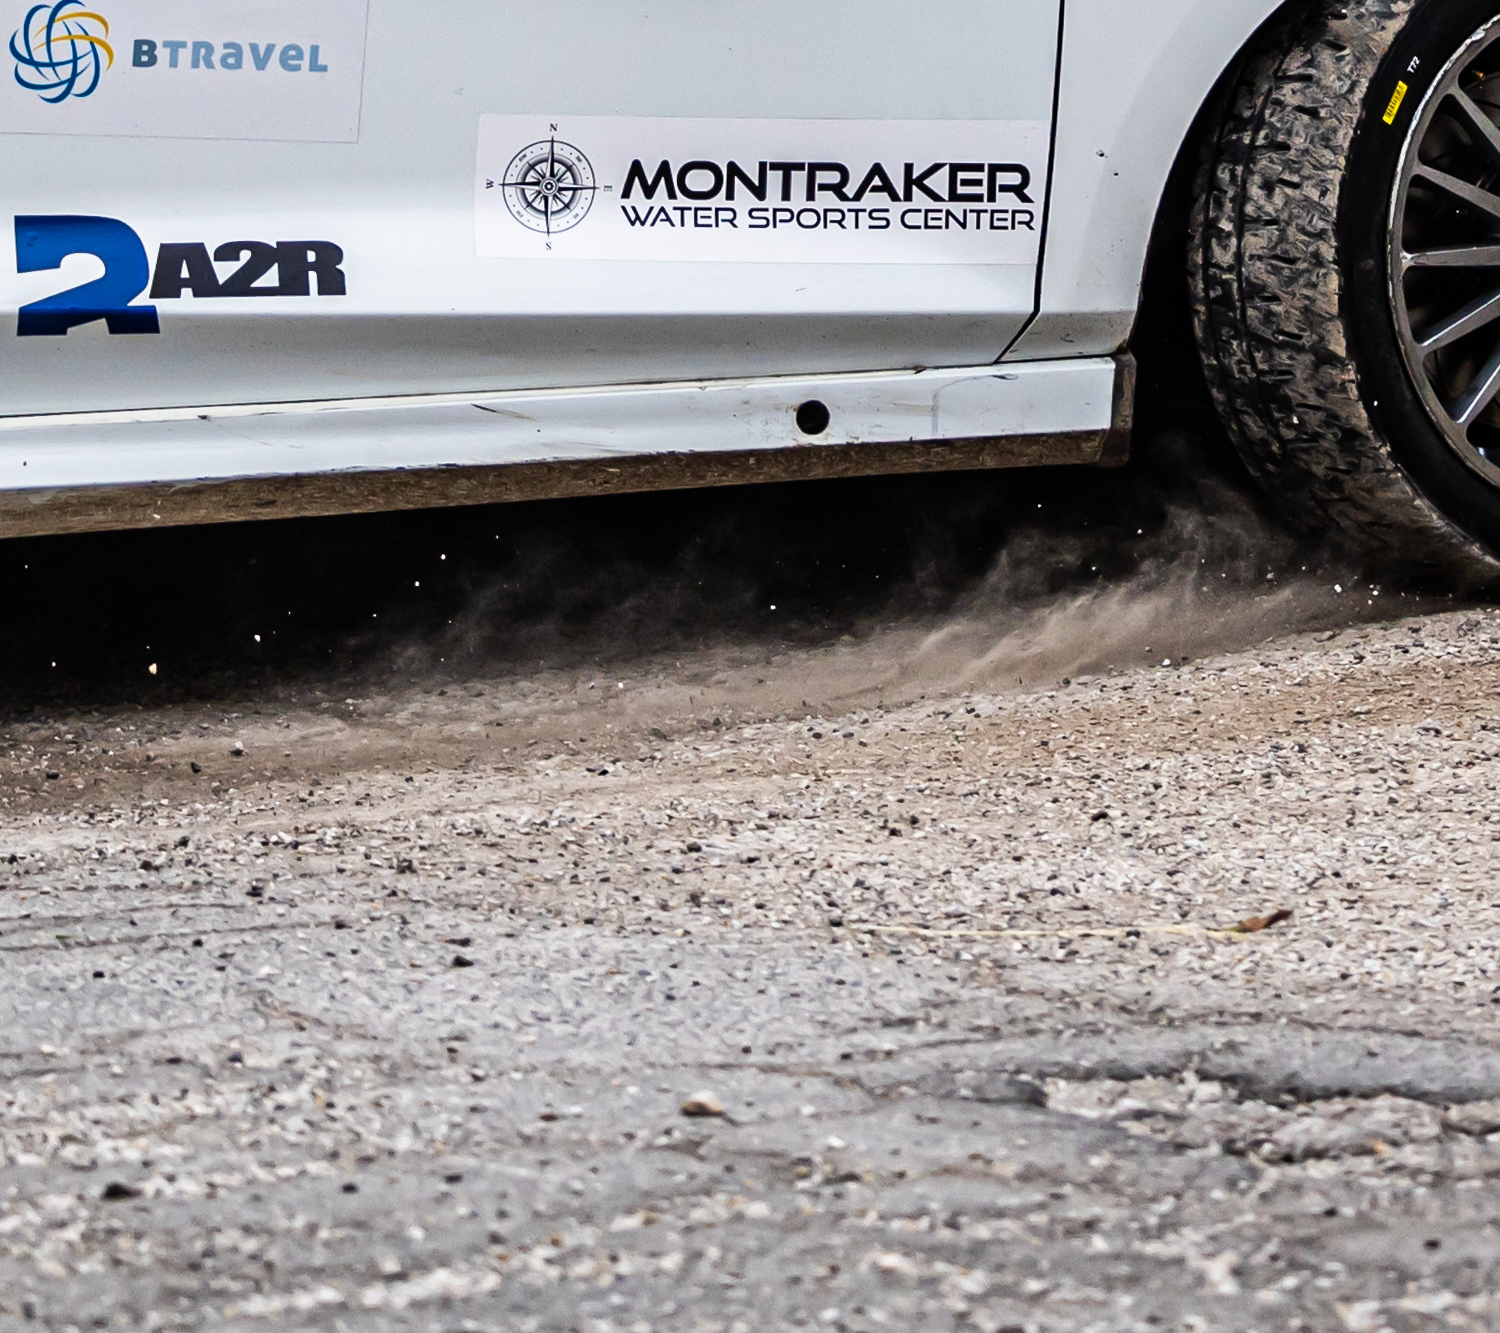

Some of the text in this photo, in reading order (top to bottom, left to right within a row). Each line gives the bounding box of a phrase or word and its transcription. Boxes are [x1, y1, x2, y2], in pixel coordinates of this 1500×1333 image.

[621, 159, 1035, 204] MONTRAKER
[620, 205, 1036, 231] WATER SPORTS CENTER
[149, 241, 347, 299] A2R
